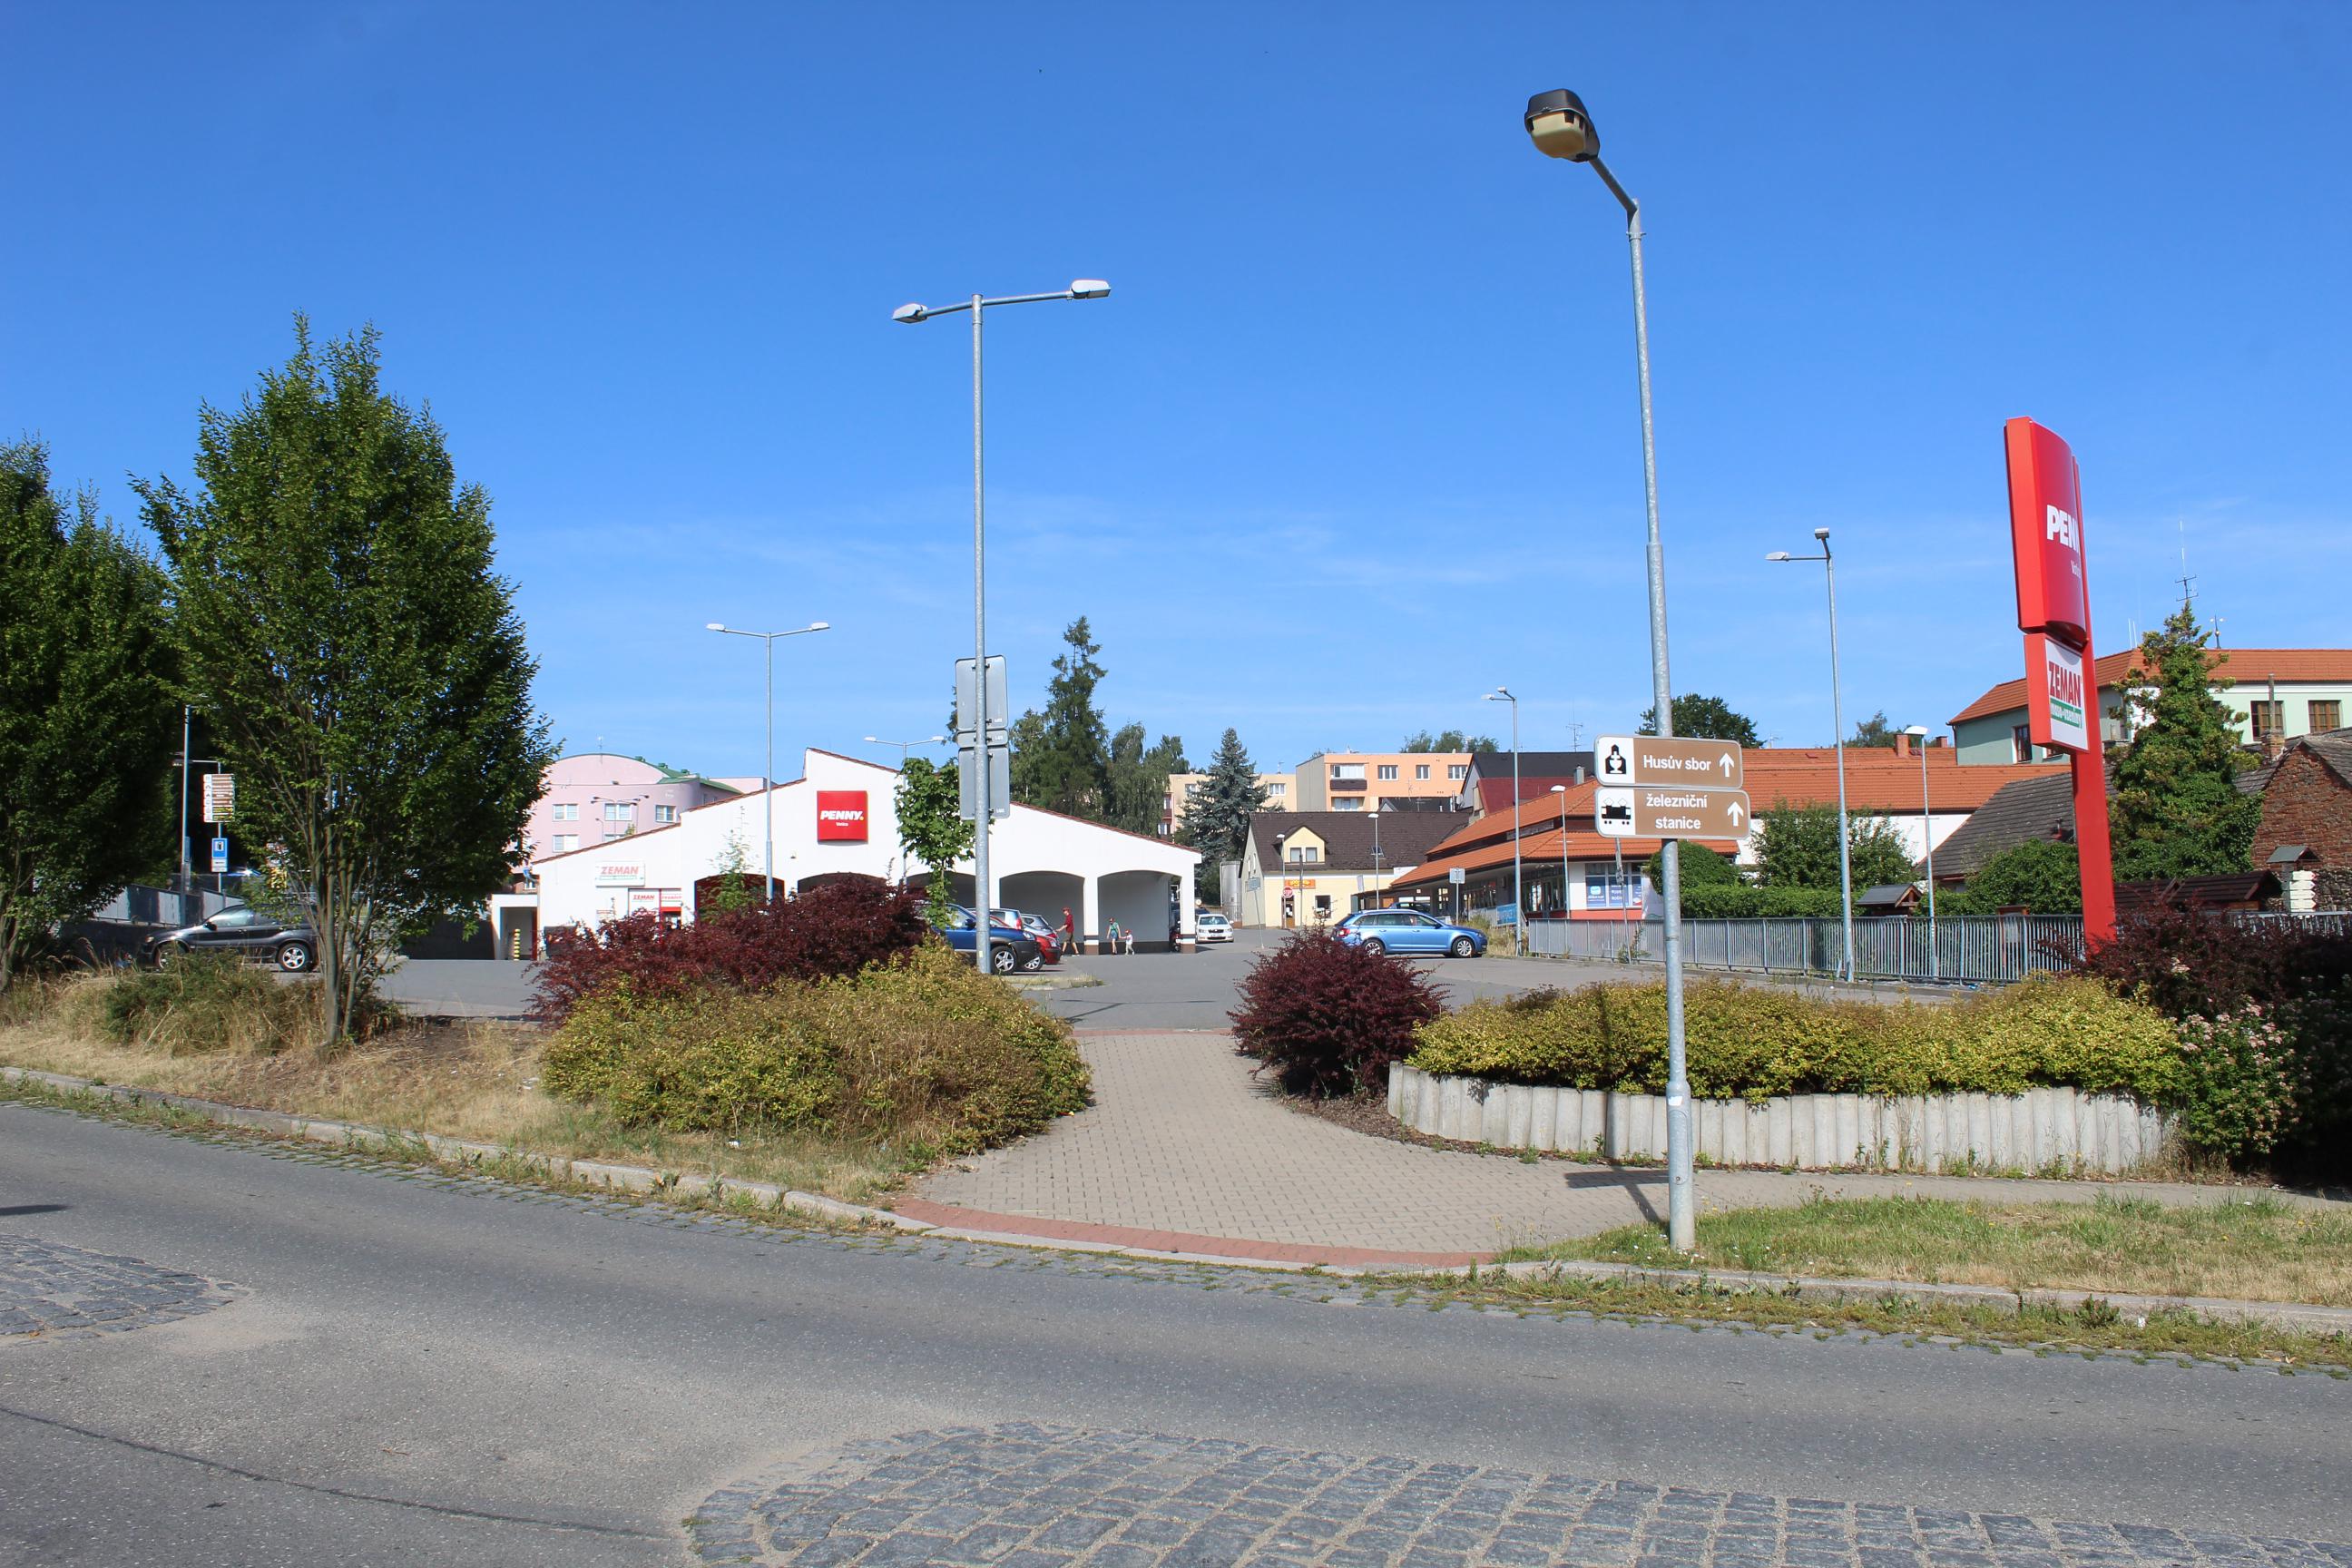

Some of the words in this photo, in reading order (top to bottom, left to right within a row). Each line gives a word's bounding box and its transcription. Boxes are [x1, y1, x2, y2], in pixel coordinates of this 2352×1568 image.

[2048, 660, 2082, 708] ZEMAN
[1643, 754, 1683, 769] Husův
[1684, 757, 1712, 771] sbor
[1646, 792, 1709, 808] železniční
[1655, 816, 1701, 829] stanice
[600, 866, 640, 875] ZEMAN
